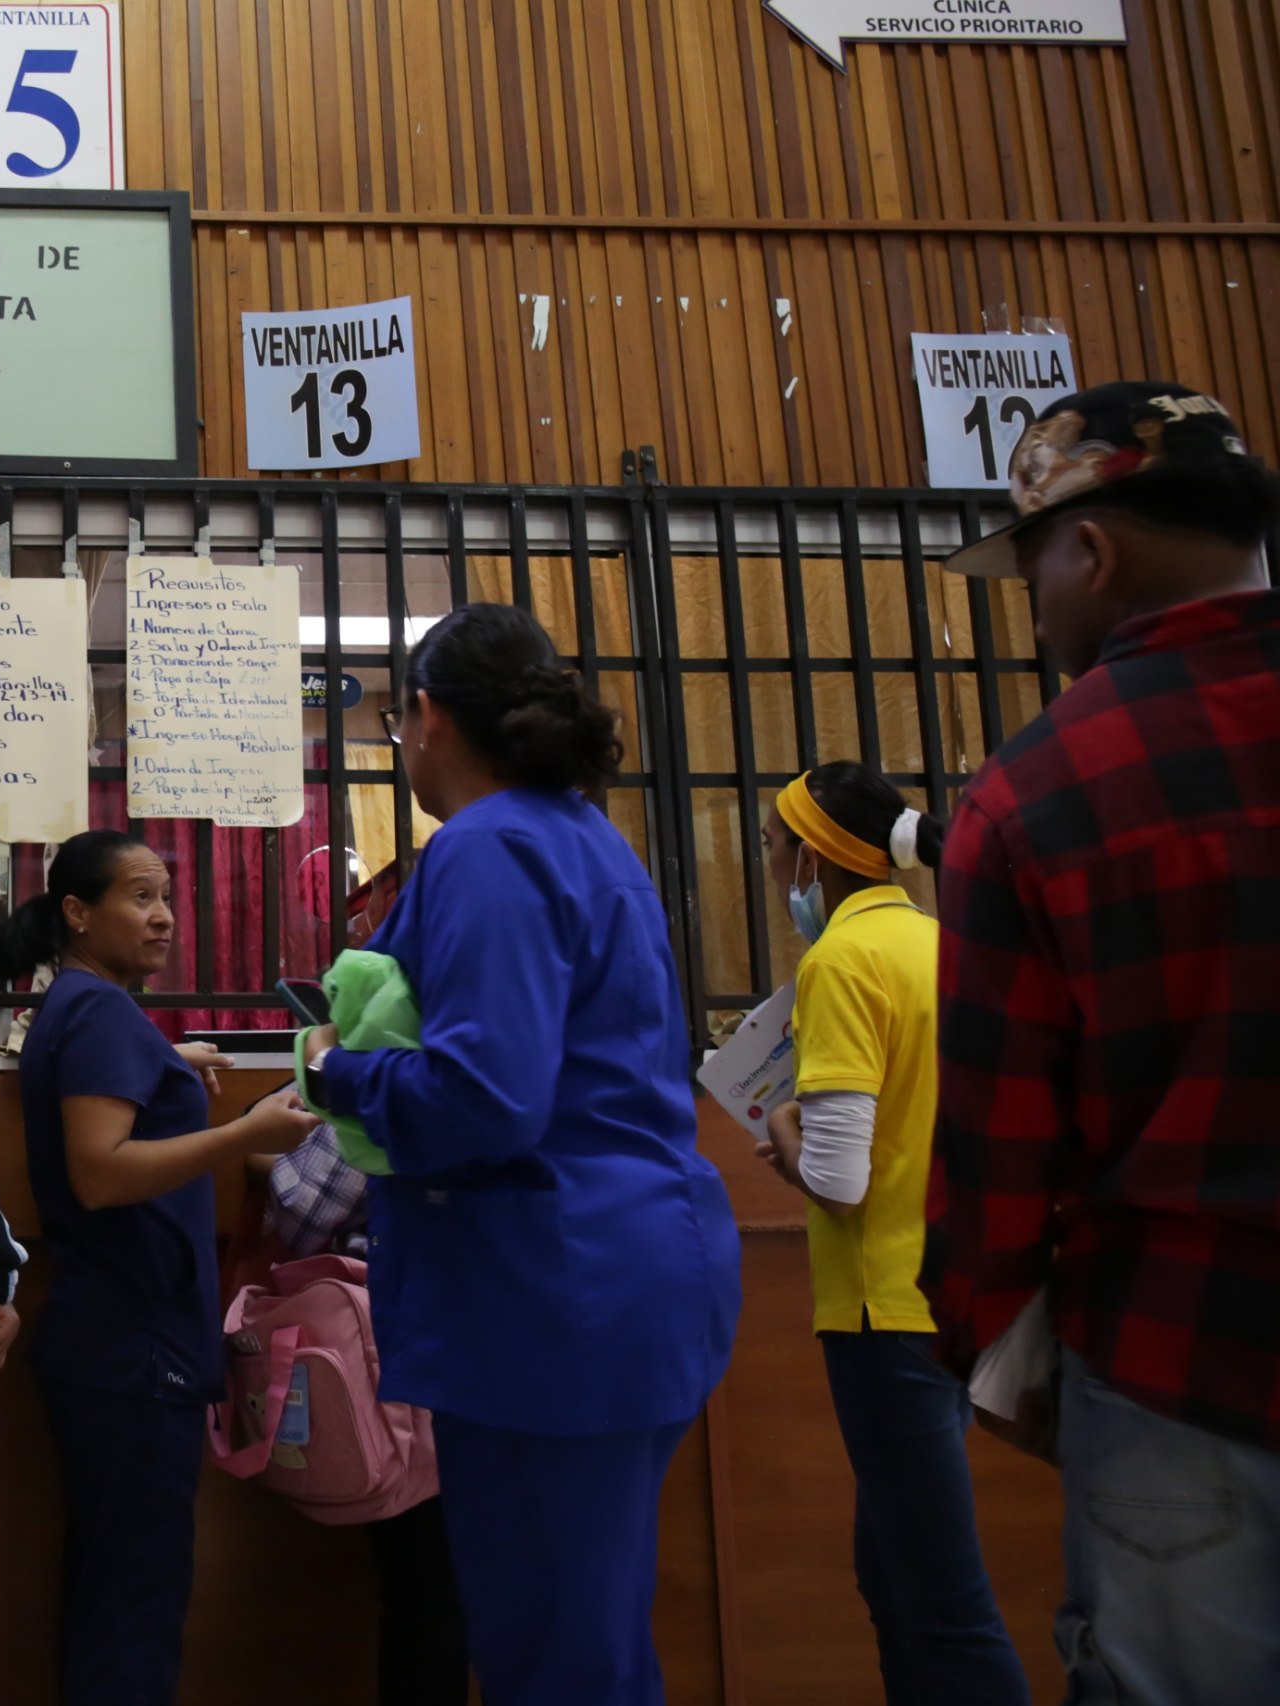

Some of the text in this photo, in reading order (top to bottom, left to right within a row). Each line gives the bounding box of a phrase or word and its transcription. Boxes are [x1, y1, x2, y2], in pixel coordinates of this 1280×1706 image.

[865, 18, 1083, 34] SERVICIO PRIORITARIO
[5, 49, 81, 179] 5
[38, 245, 81, 271] DE
[251, 315, 404, 366] VENTANILLA
[921, 349, 1068, 389] VENTANILLA
[291, 369, 372, 458] 13
[129, 590, 212, 617] Ingresos
[217, 601, 227, 610] a
[3, 705, 44, 722] dan
